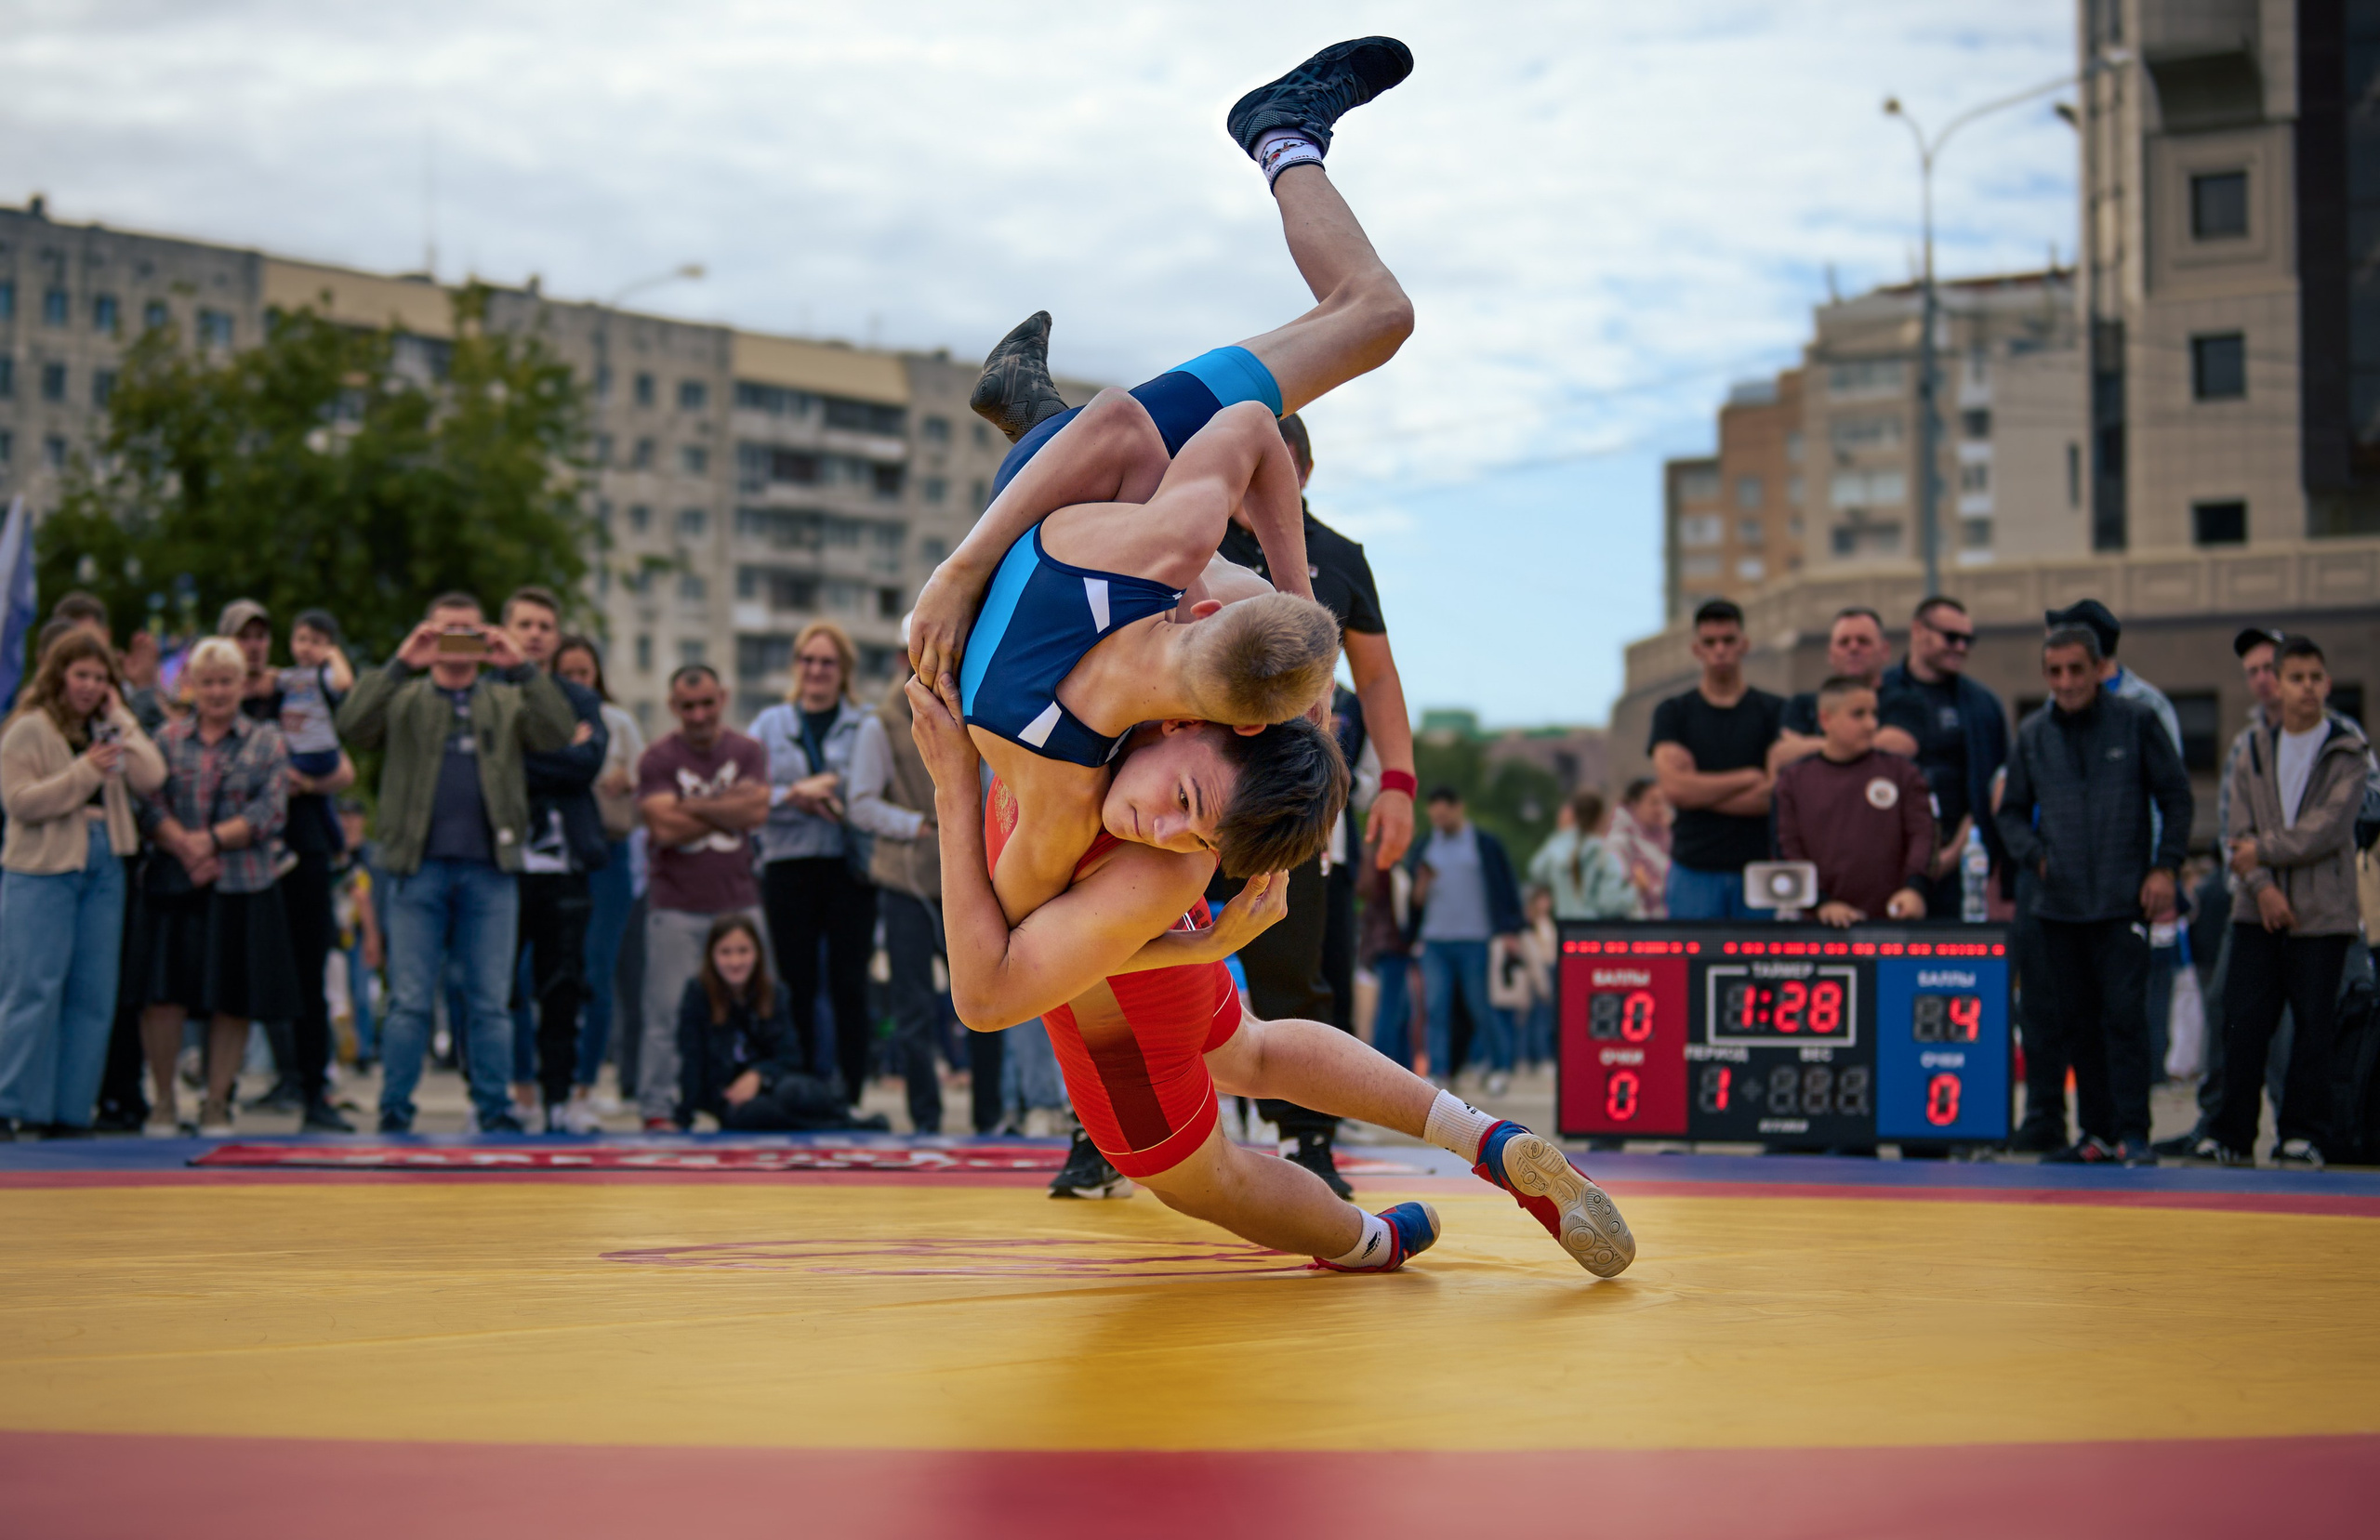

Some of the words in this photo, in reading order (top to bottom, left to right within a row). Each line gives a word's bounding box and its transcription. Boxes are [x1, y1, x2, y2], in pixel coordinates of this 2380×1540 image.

[1592, 969, 1651, 987] БАЛЛЫ
[1620, 990, 1655, 1042] 0
[1741, 981, 1843, 1033] 1:28
[1949, 996, 1981, 1042] 4
[1606, 1069, 1640, 1121] 0
[1715, 1066, 1732, 1111] 1
[1926, 1073, 1962, 1125] 0
